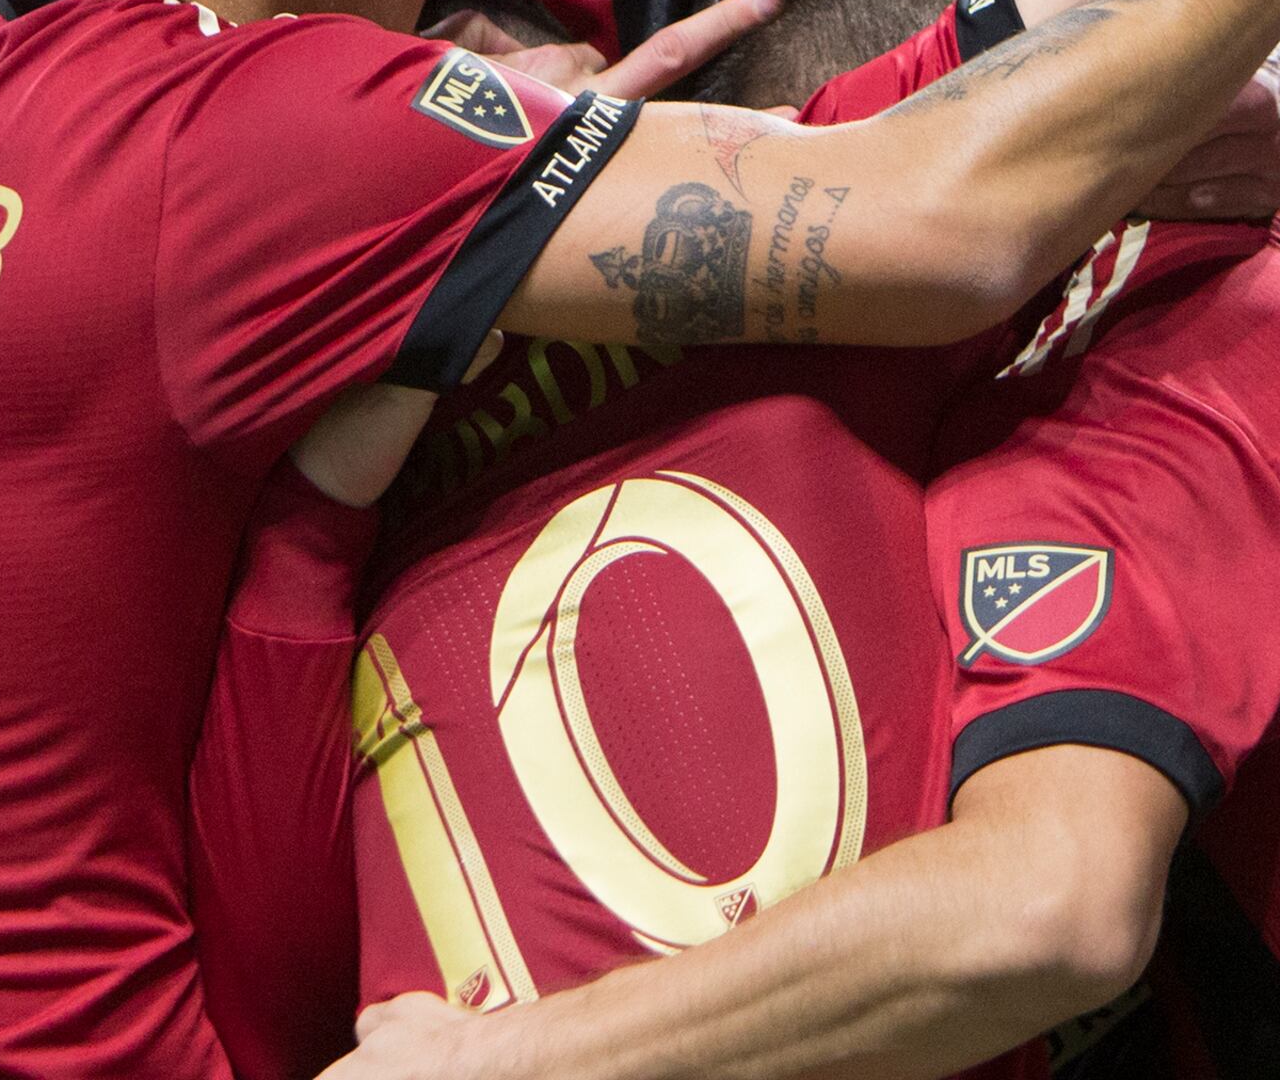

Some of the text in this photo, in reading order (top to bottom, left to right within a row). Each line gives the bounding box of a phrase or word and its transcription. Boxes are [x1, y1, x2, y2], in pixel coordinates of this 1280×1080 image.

[436, 63, 487, 114] MLS
[976, 553, 1051, 583] MLS
[352, 470, 868, 1012] 10
